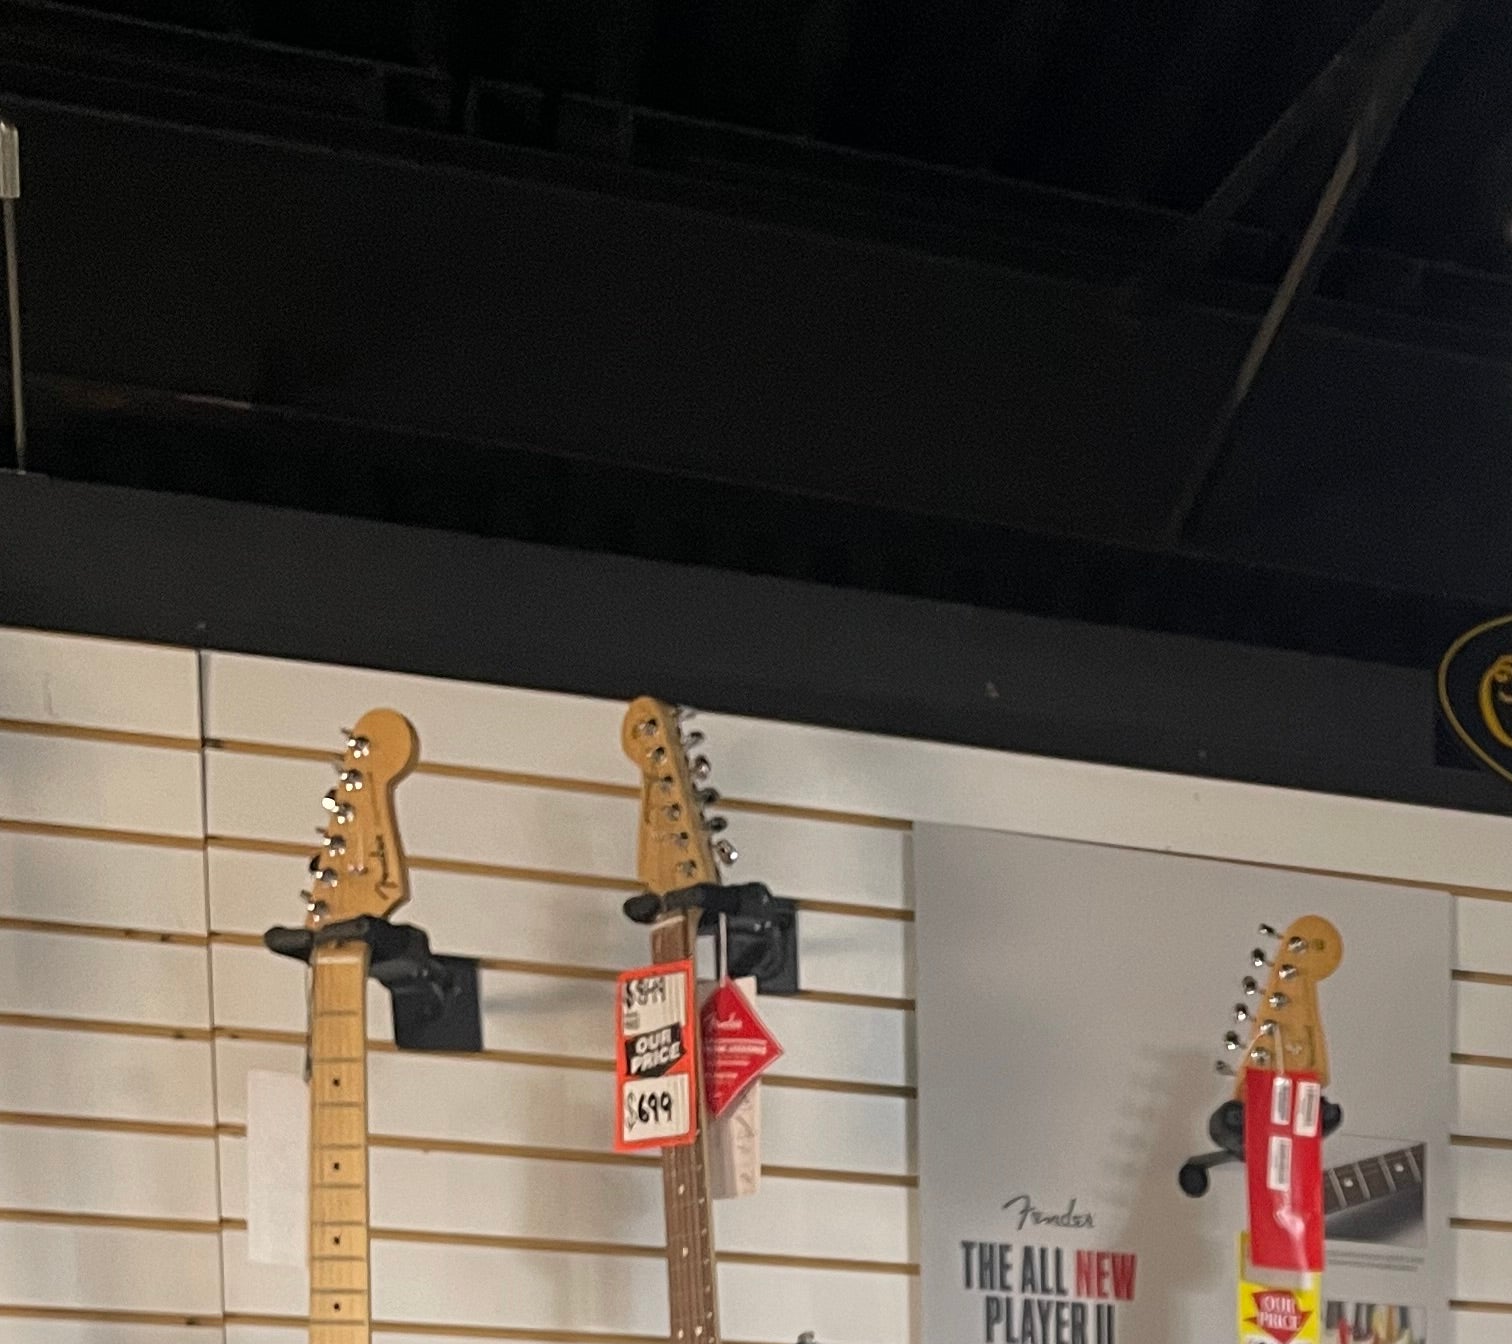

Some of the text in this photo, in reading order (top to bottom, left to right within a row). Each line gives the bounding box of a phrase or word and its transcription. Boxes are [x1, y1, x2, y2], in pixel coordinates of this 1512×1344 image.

[635, 1028, 672, 1054] OUR
[630, 1041, 680, 1074] PRICE
[1002, 1194, 1096, 1231] Fender
[960, 1239, 1137, 1301] THE ALL NEW
[1264, 1296, 1296, 1313] OUR
[1258, 1311, 1299, 1331] PRICE
